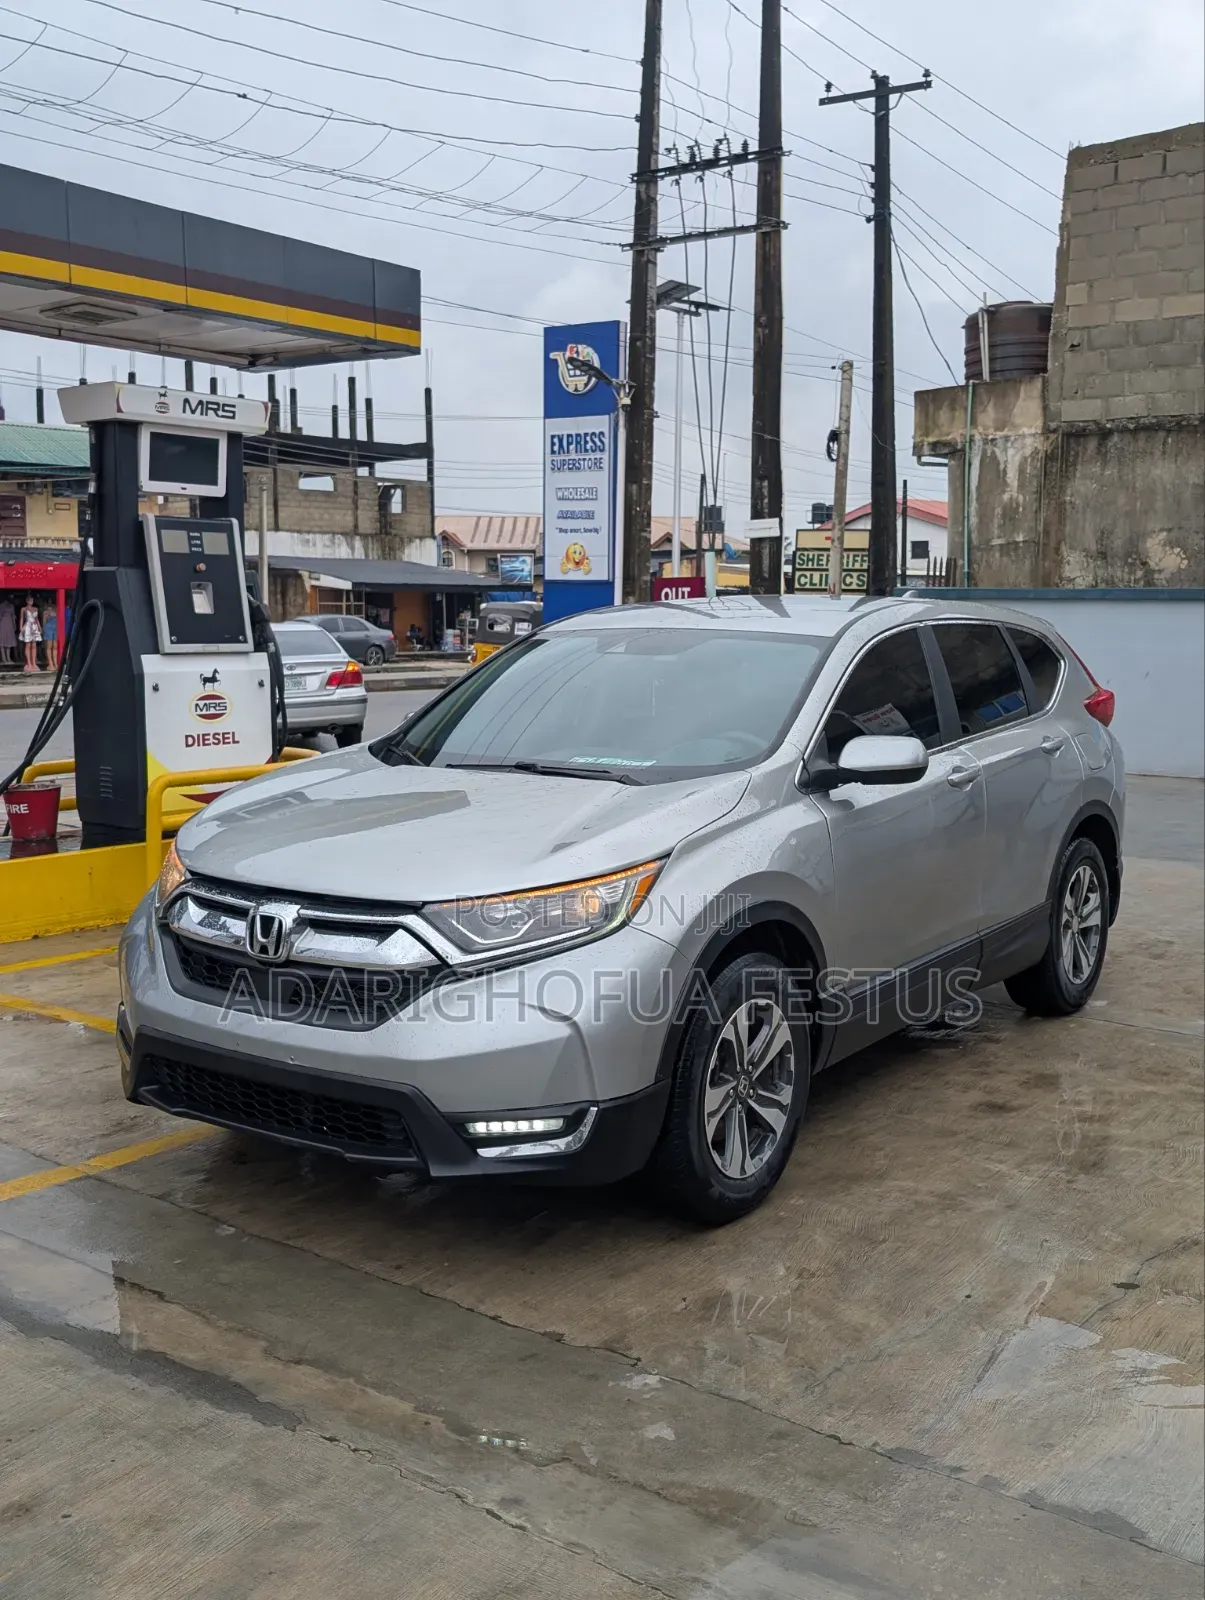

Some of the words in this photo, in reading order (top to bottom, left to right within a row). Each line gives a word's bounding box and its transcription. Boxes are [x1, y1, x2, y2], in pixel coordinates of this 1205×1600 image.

[182, 397, 237, 420] MRS
[550, 431, 606, 456] EXPRESS
[550, 457, 604, 472] SUPERSTORE
[555, 487, 598, 501] WHOLESALE
[556, 509, 596, 520] AVAILABLE
[797, 552, 869, 568] SHEIFF
[796, 573, 867, 588] CLICS
[661, 587, 691, 601] OUT
[195, 701, 228, 713] MRS
[184, 731, 240, 748] DIESEL
[6, 803, 30, 814] FIRE
